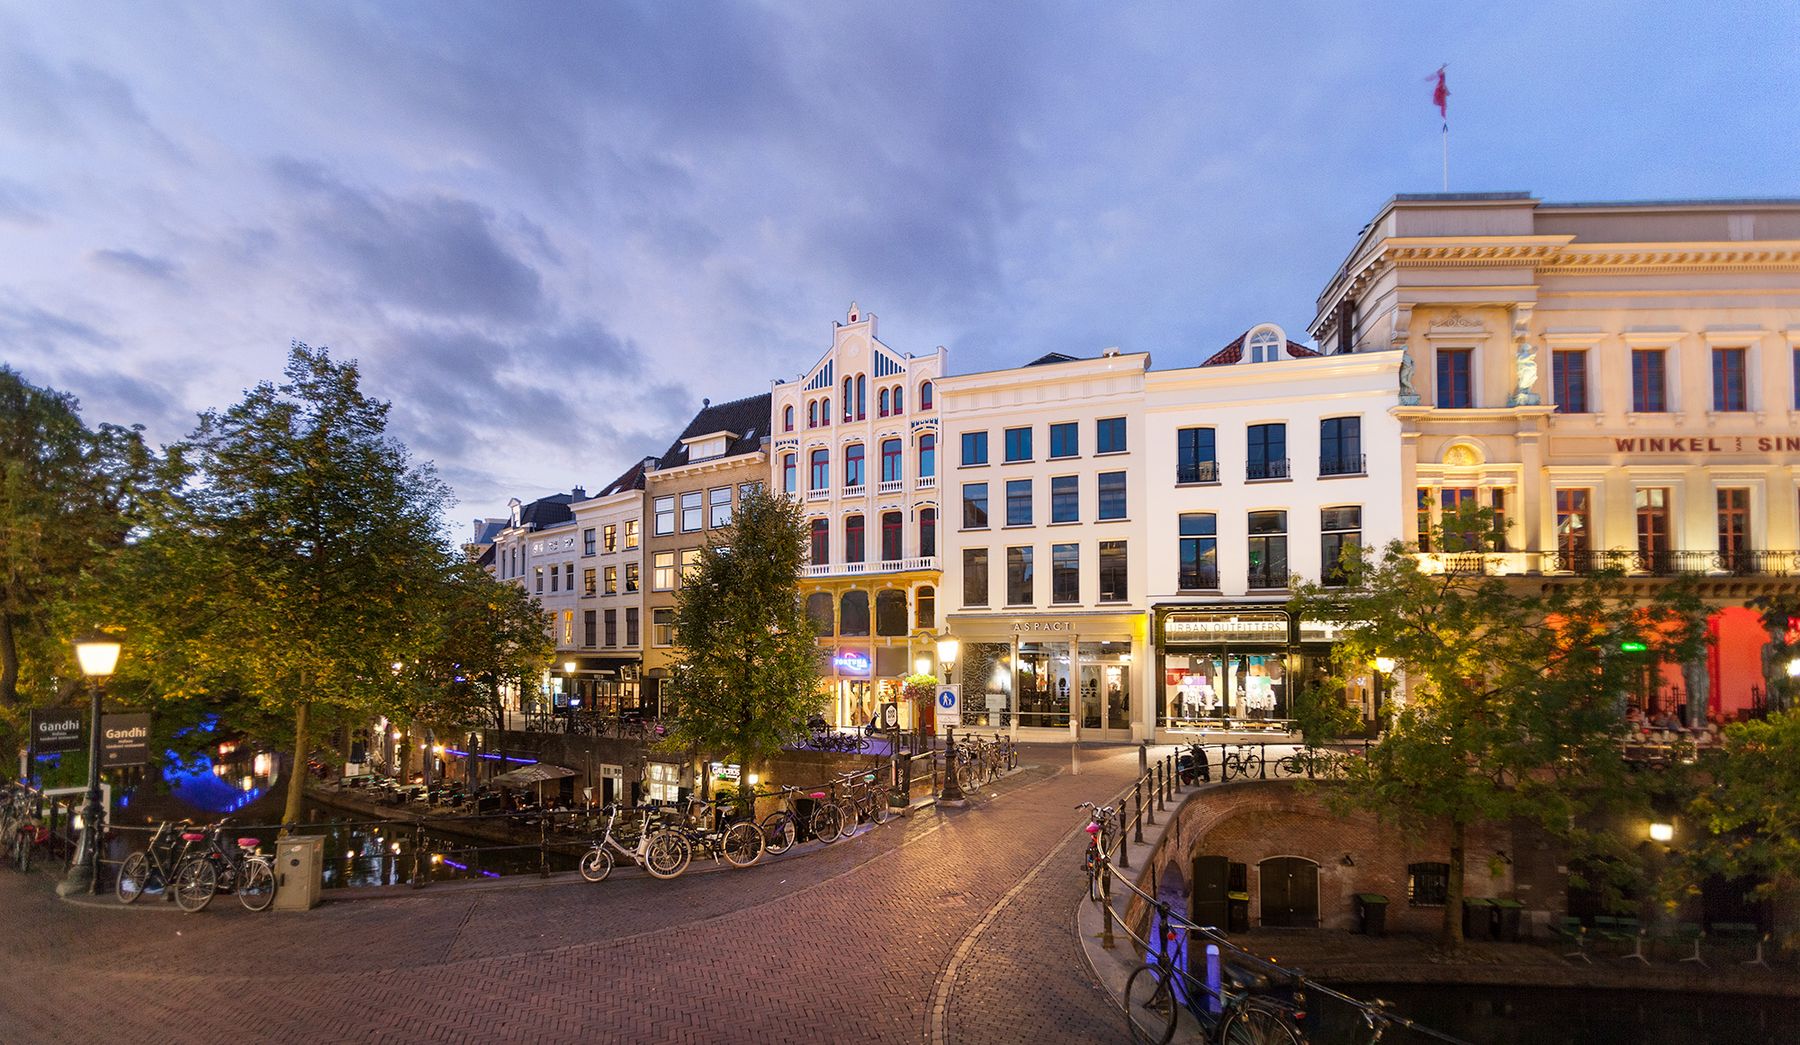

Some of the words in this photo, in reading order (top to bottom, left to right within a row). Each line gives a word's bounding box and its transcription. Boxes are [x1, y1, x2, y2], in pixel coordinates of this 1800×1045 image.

[1615, 438, 1721, 452] WINKEL
[1758, 438, 1800, 451] SIN
[1169, 623, 1208, 632] URBAN
[1213, 623, 1281, 632] OUTFITTERS
[39, 720, 80, 732] Gandhi
[105, 727, 146, 739] Gandhi
